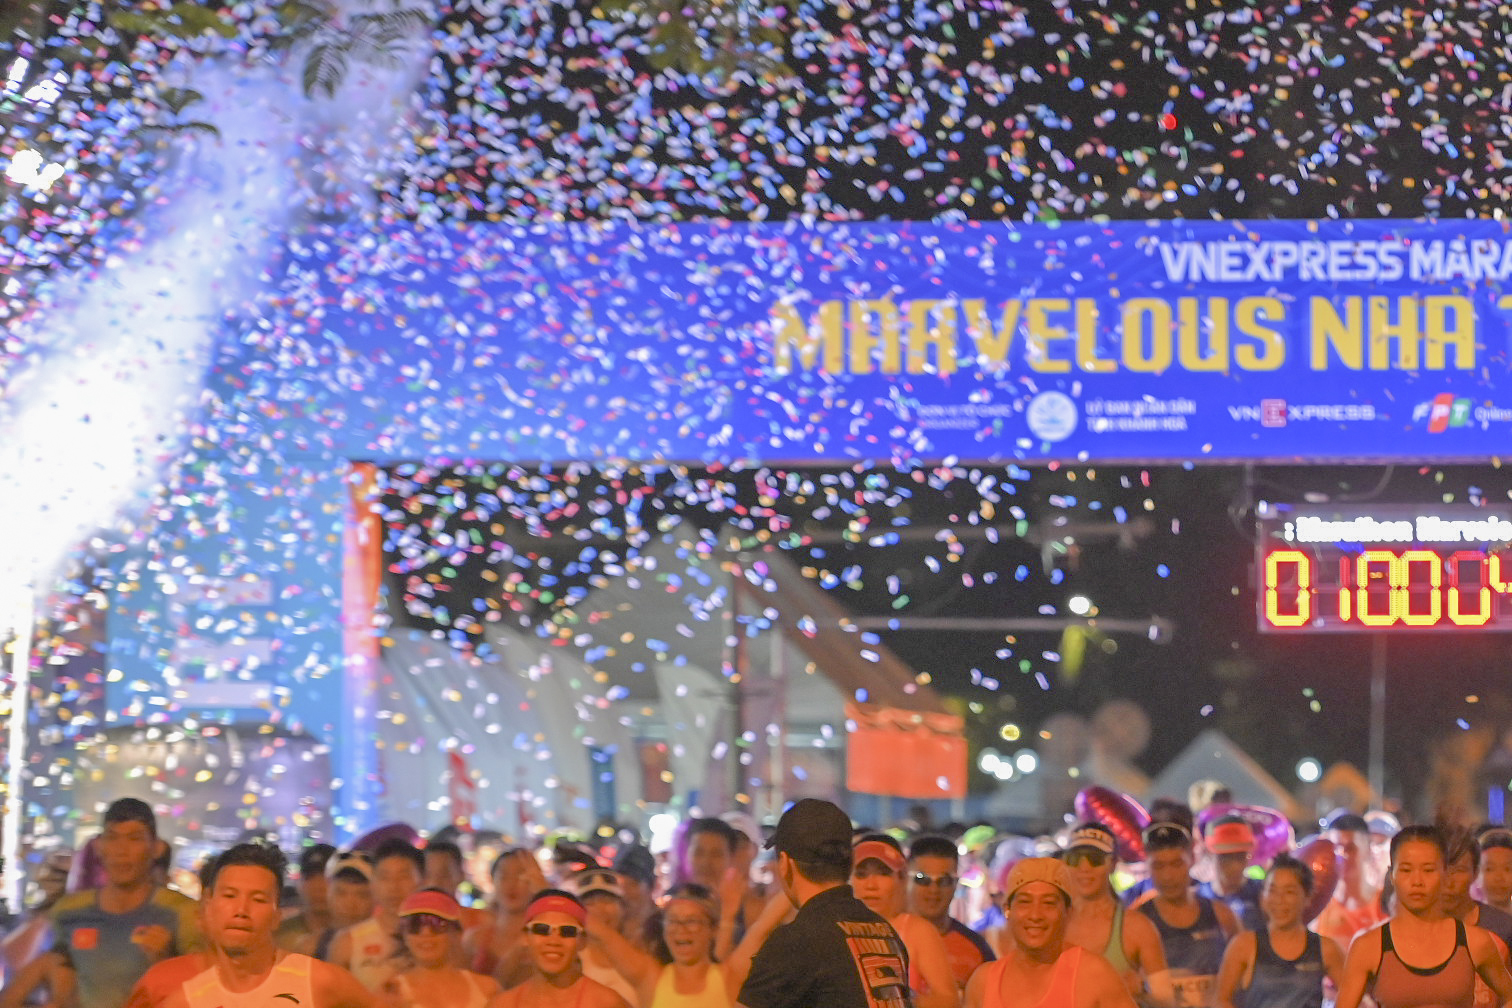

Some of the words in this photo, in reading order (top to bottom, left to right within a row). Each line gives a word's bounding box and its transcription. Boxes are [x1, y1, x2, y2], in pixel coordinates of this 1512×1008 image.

[1160, 240, 1403, 283] VNEXPRESS
[774, 297, 1287, 374] MARVELOUS
[1310, 295, 1476, 371] NHA
[1228, 399, 1376, 427] VNEXPRESS
[1412, 394, 1471, 431] FPT
